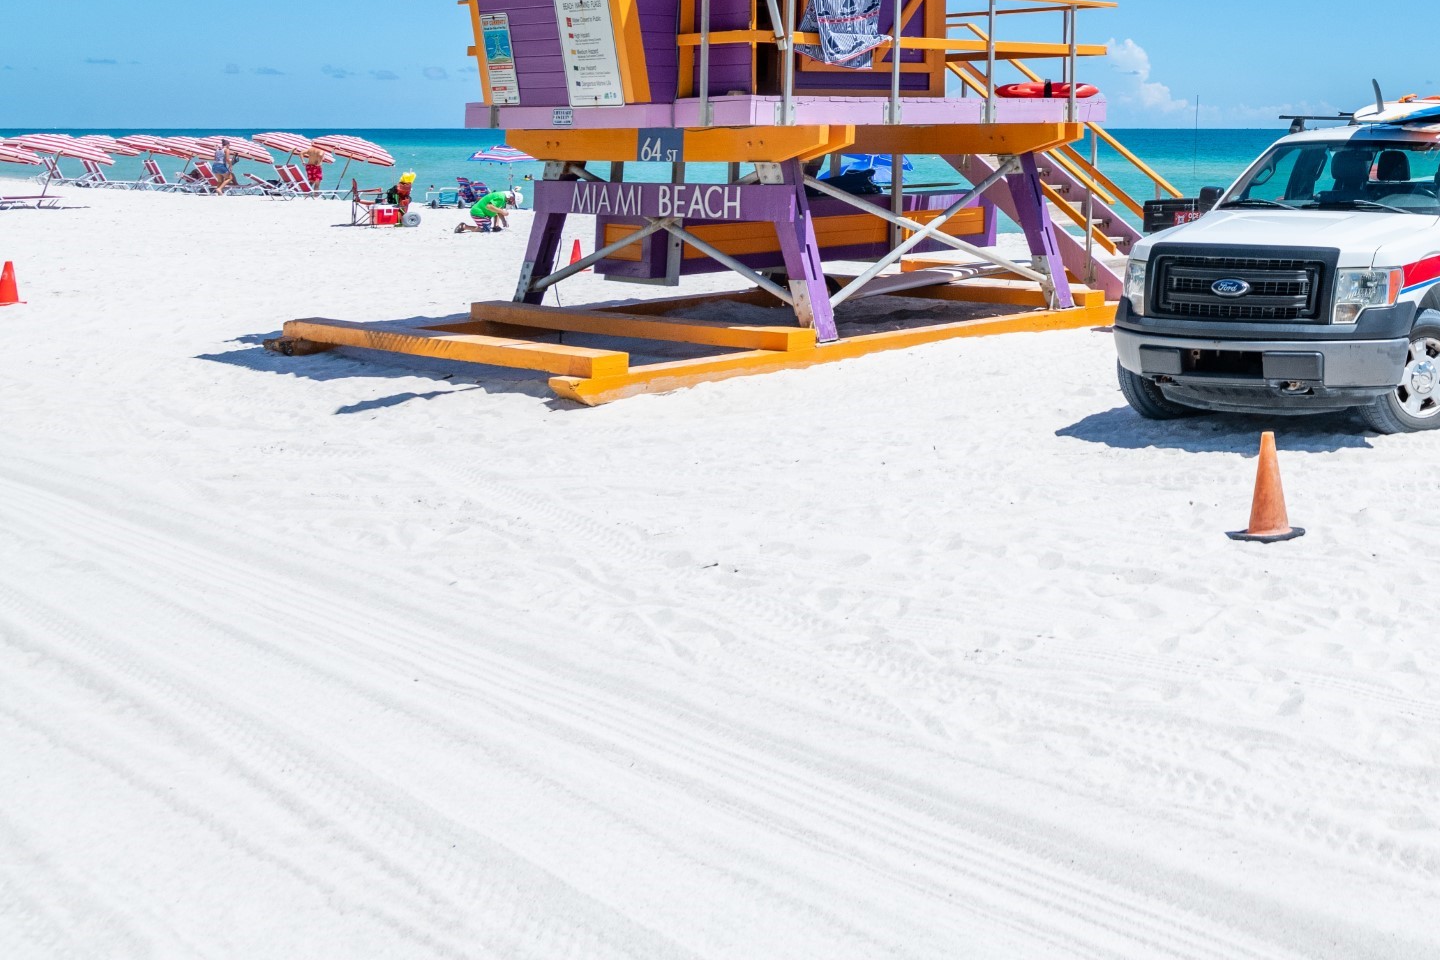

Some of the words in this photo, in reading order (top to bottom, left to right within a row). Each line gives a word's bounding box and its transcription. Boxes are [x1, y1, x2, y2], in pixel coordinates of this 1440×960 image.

[641, 137, 662, 162] 64
[666, 149, 678, 162] ST
[570, 182, 642, 216] MIAMI
[658, 184, 741, 218] BEACH
[1217, 281, 1239, 292] Ford
